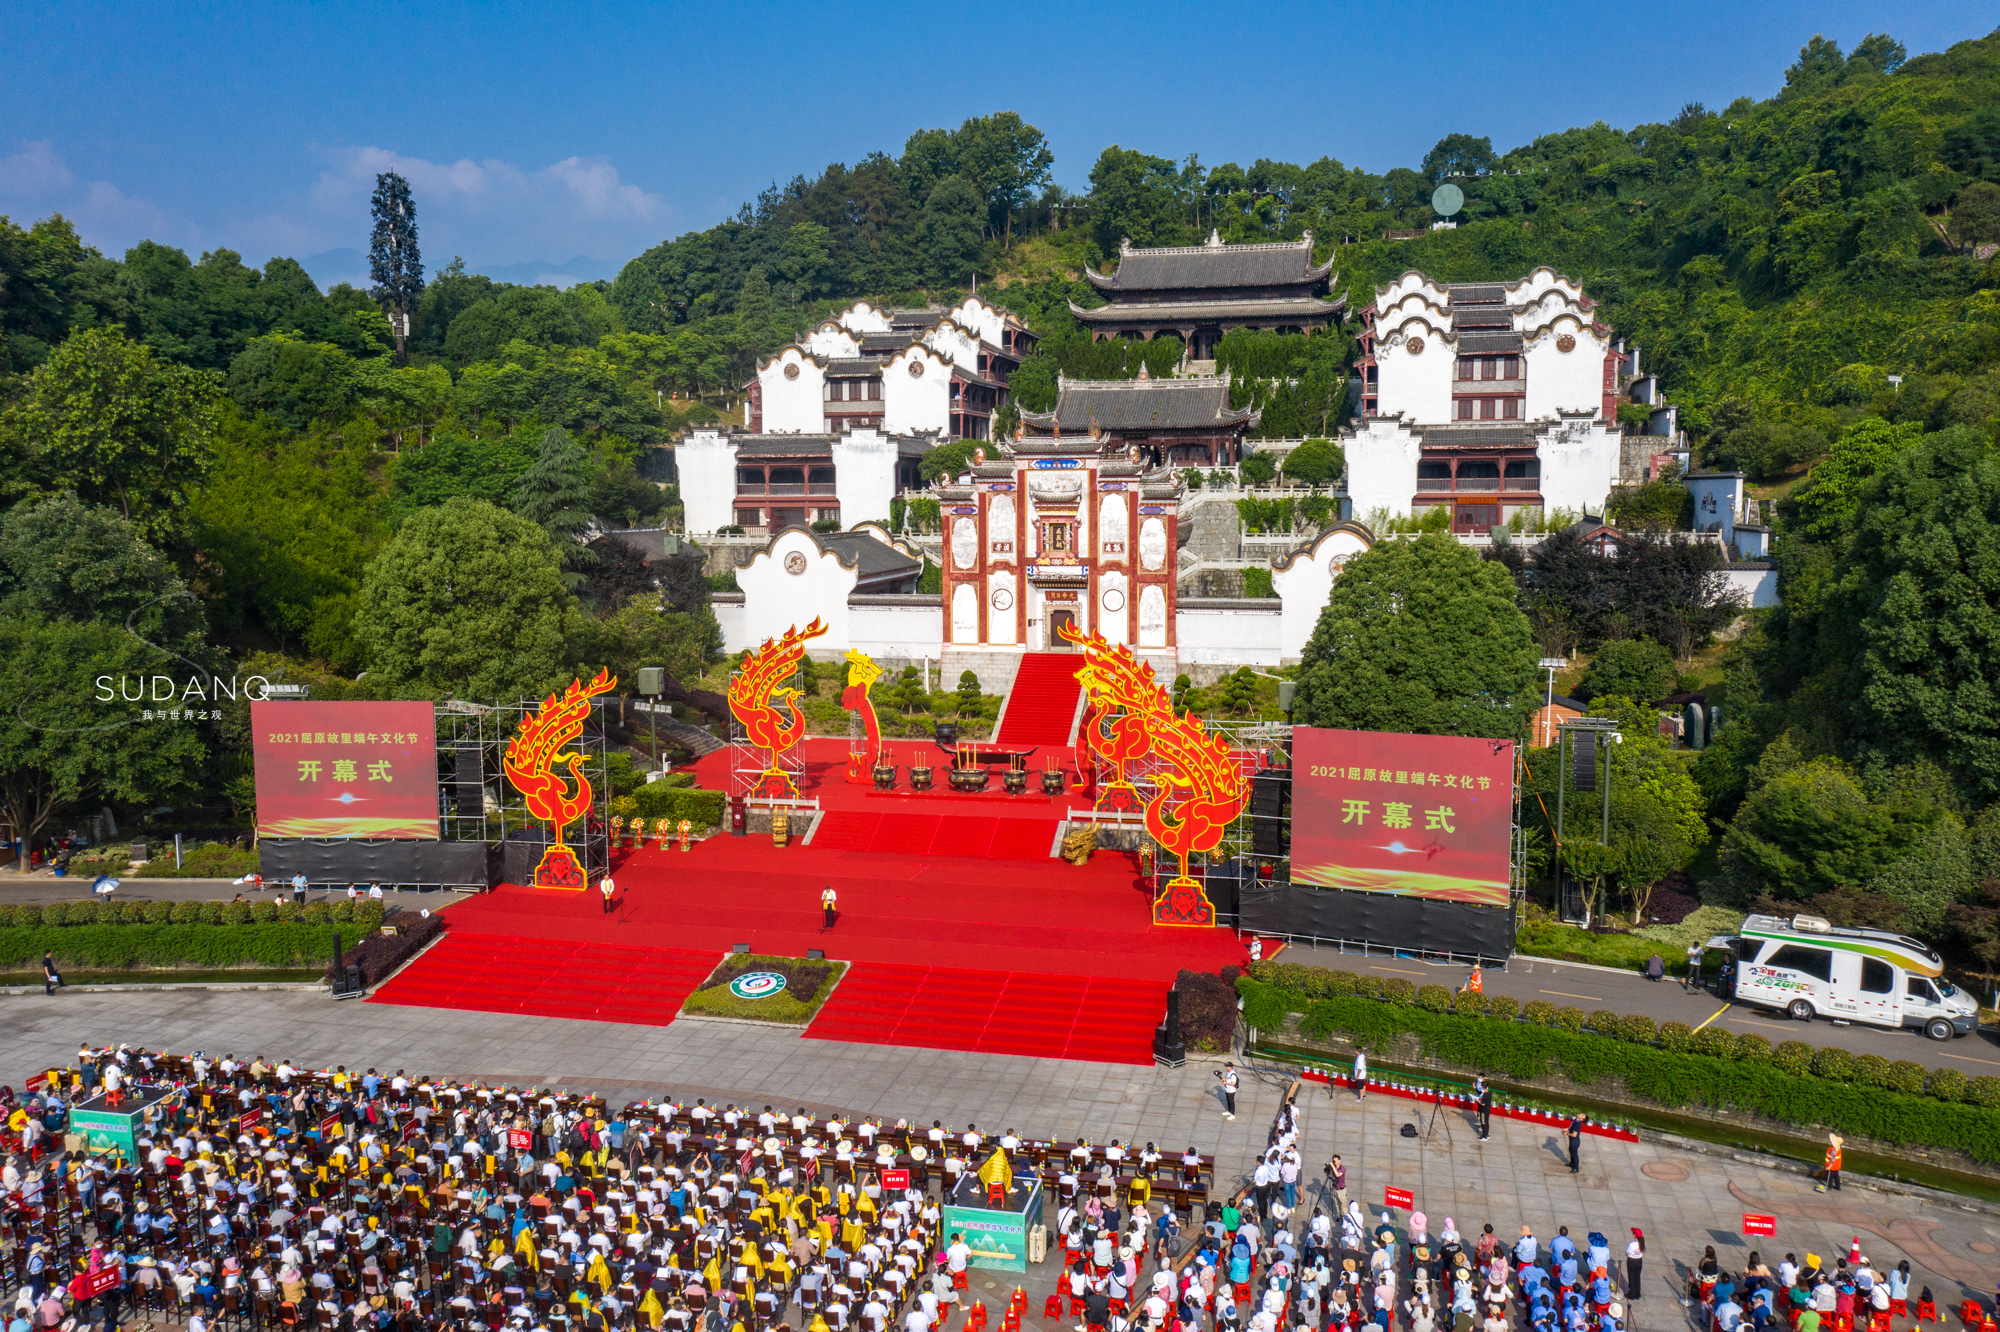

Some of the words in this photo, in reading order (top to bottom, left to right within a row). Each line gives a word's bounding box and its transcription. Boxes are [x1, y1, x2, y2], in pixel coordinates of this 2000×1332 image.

[269, 732, 418, 745] 2021屈原故里端午文化节
[297, 759, 393, 783] 开幕式
[1310, 765, 1491, 791] 2021屈原故里端午文化节
[1341, 799, 1456, 834] 开幕式
